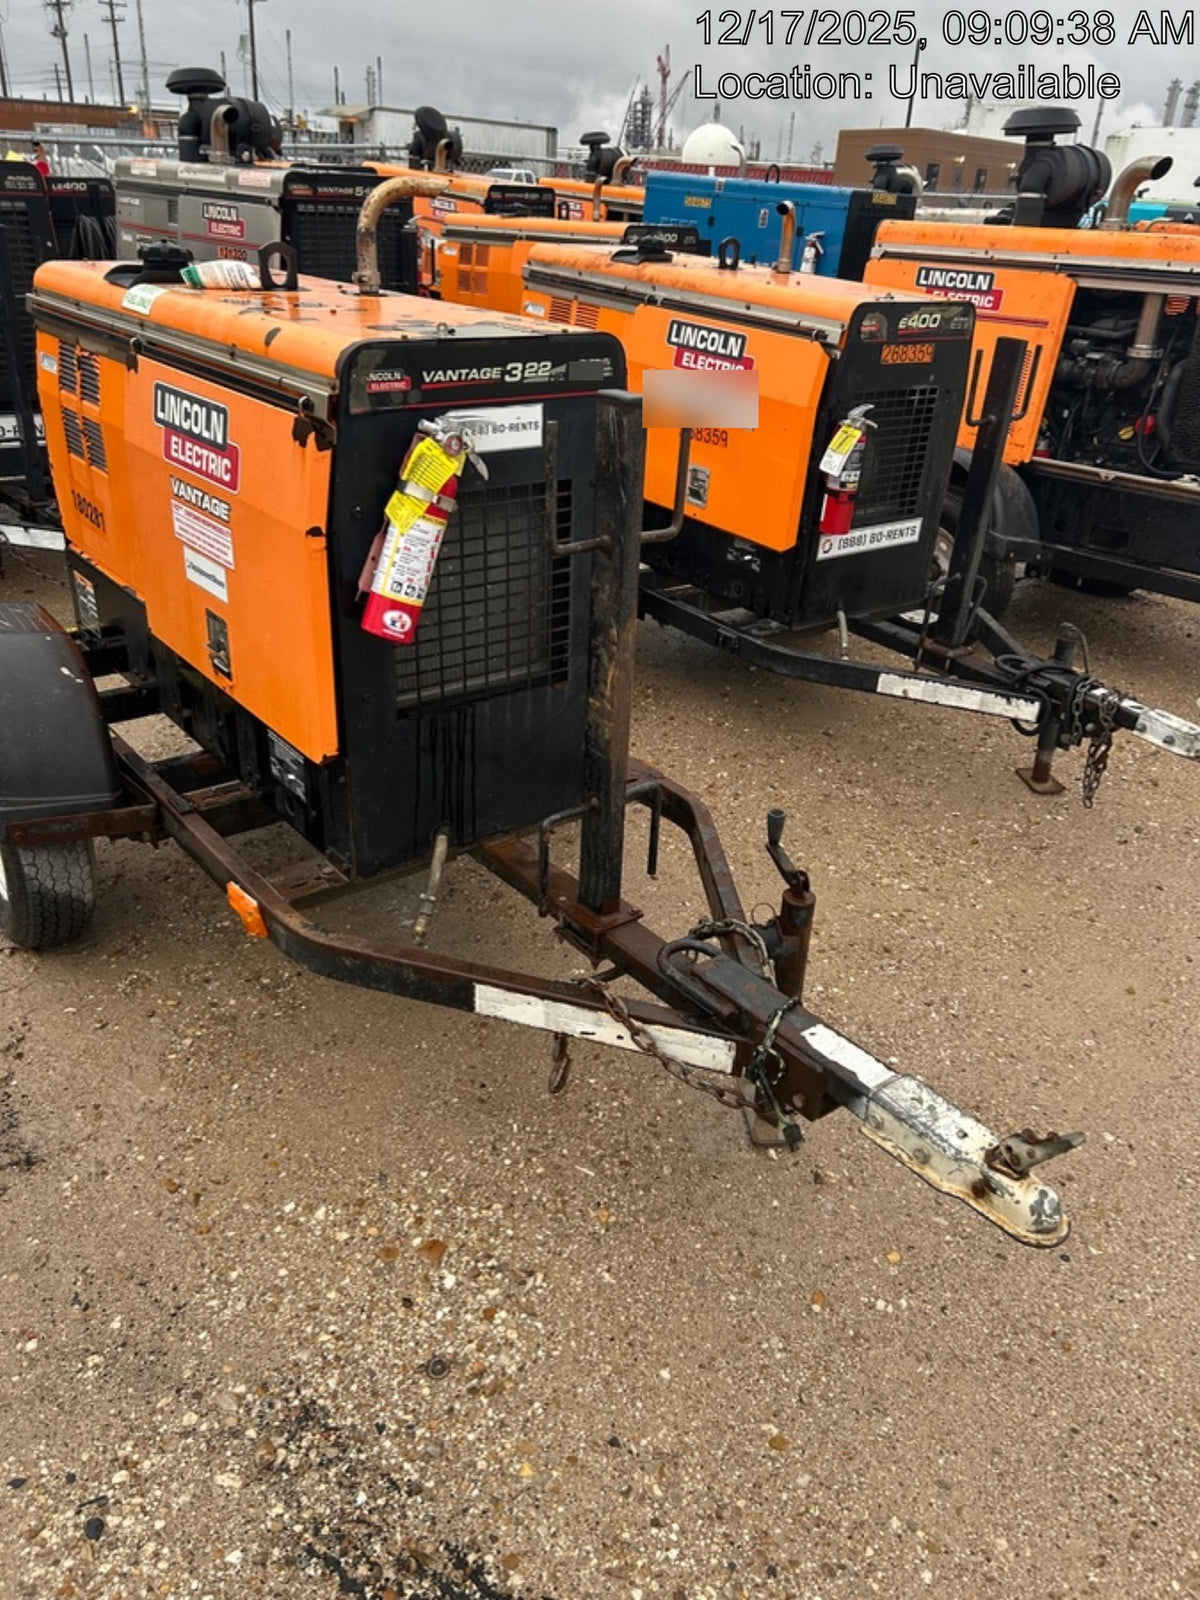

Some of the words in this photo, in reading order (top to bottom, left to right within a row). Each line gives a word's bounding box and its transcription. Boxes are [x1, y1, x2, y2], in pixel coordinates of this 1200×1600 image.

[203, 204, 238, 222] LINCOLN
[918, 269, 992, 291] LINCOLN
[898, 314, 942, 329] E400
[671, 323, 743, 357] LINCOLN
[421, 367, 502, 383] VANTAGE
[156, 389, 225, 445] LINCOLN
[170, 435, 232, 483] ELECTRIC
[169, 475, 232, 523] VANTAGE
